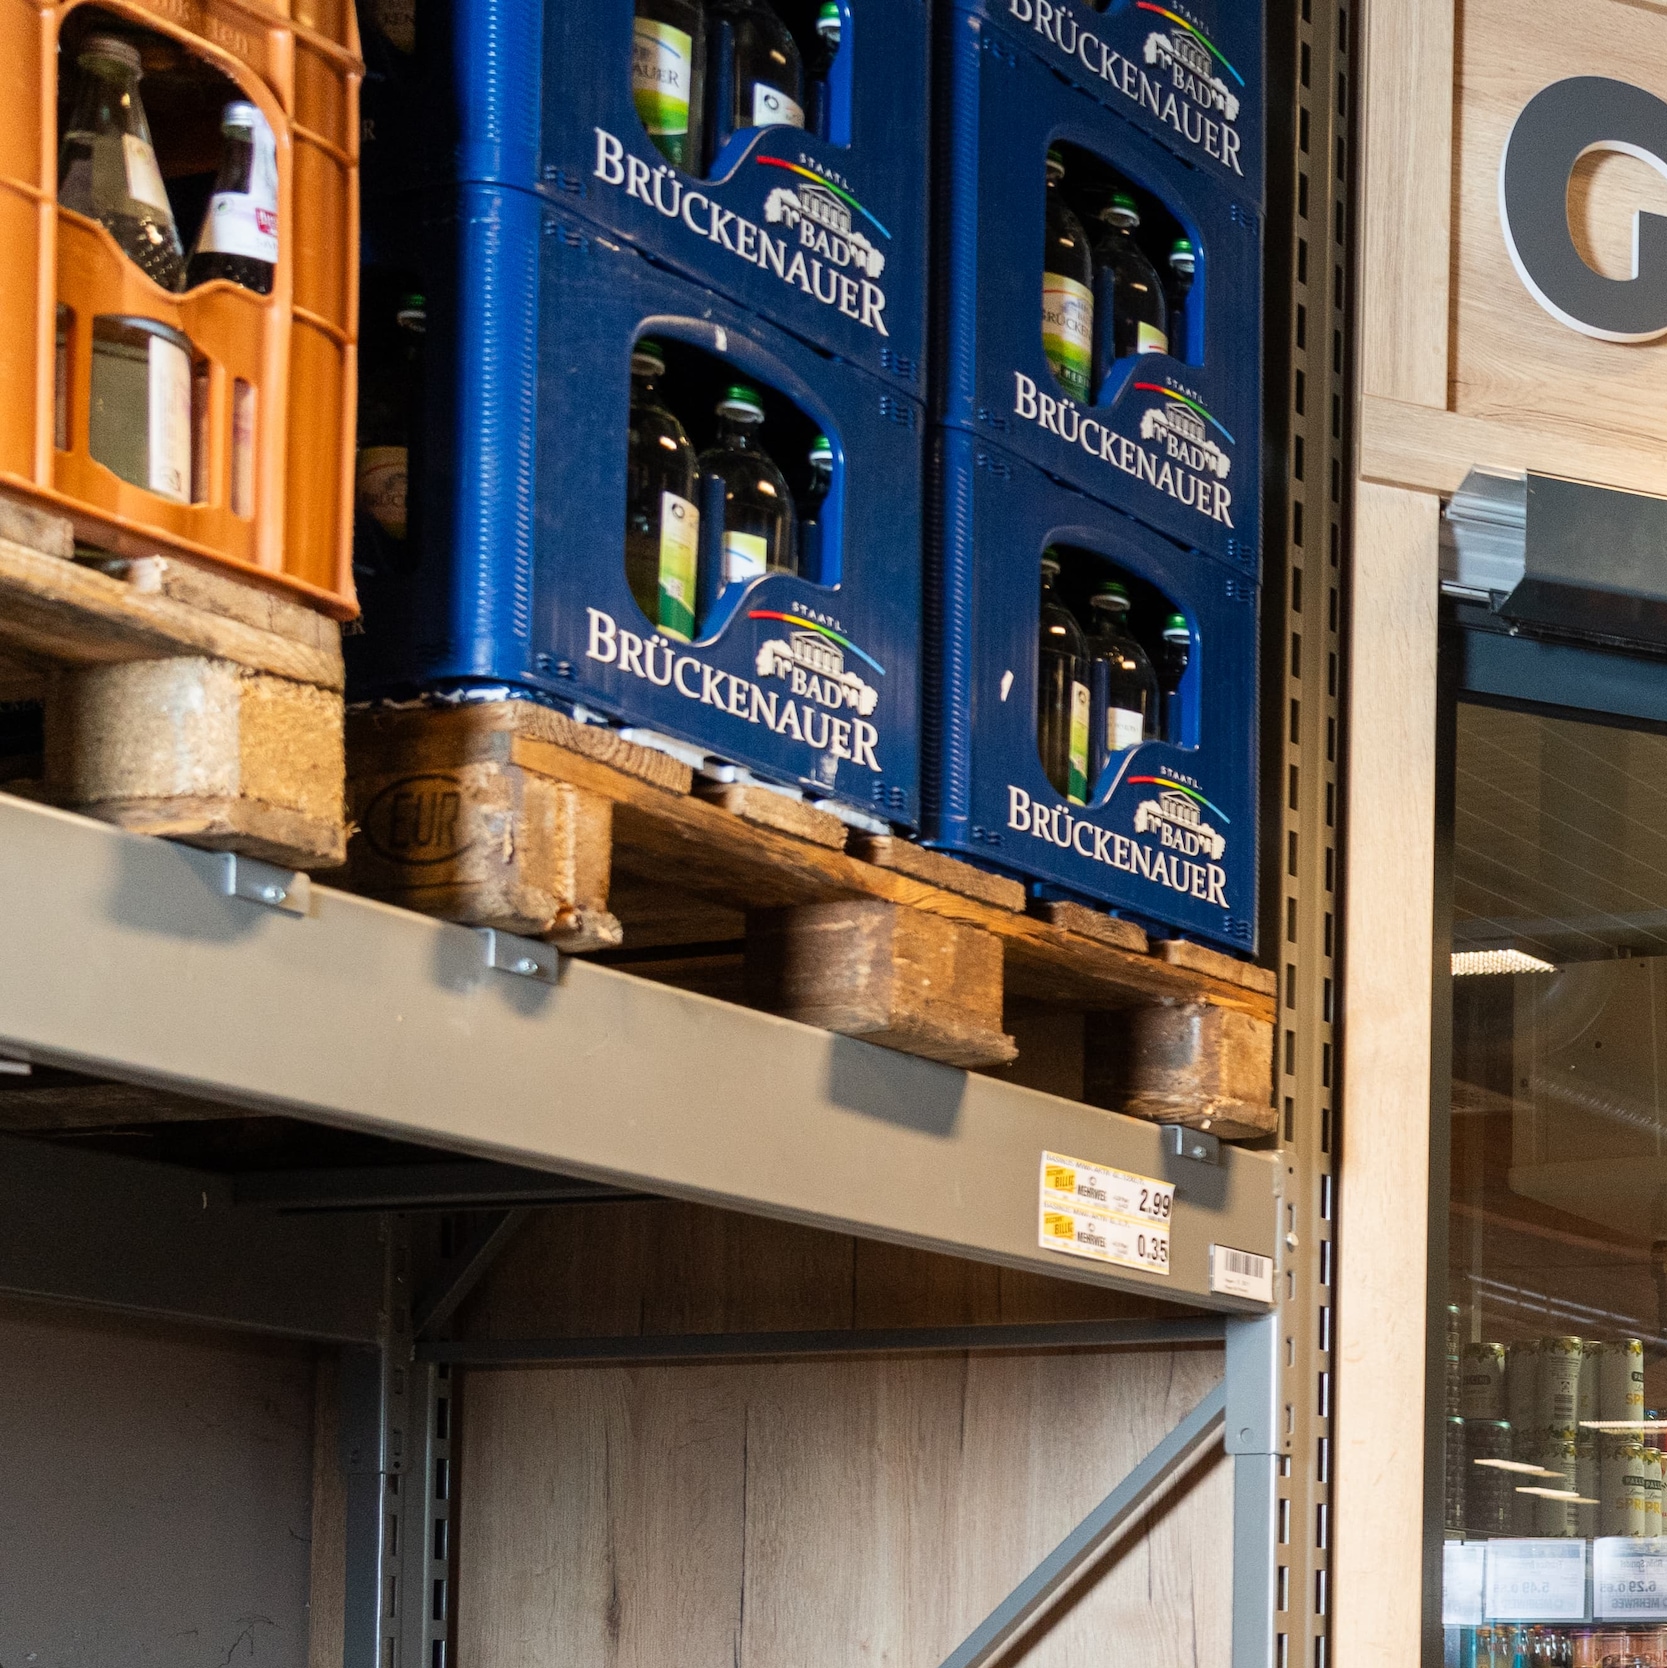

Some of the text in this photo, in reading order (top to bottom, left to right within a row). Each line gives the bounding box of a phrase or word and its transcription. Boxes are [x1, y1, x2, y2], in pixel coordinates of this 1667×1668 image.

[1172, 62, 1213, 109] BAD
[800, 152, 855, 193] STAATL.
[594, 126, 889, 337] BRÜCKENAUER
[800, 217, 851, 267] BAD
[1165, 376, 1207, 407] STAATL.
[1014, 370, 1235, 529] BRÜCKENAUER
[1167, 441, 1206, 472] BAD
[792, 601, 847, 633] STAATL.
[586, 606, 882, 772] BRÜCKENAUER
[791, 667, 843, 709] BAD
[1160, 765, 1203, 790] STAATL.
[1007, 785, 1229, 908] BRÜCKENAUER
[1161, 822, 1201, 857] BAD
[1139, 1188, 1171, 1217] 2.99
[1138, 1234, 1168, 1262] 0.35
